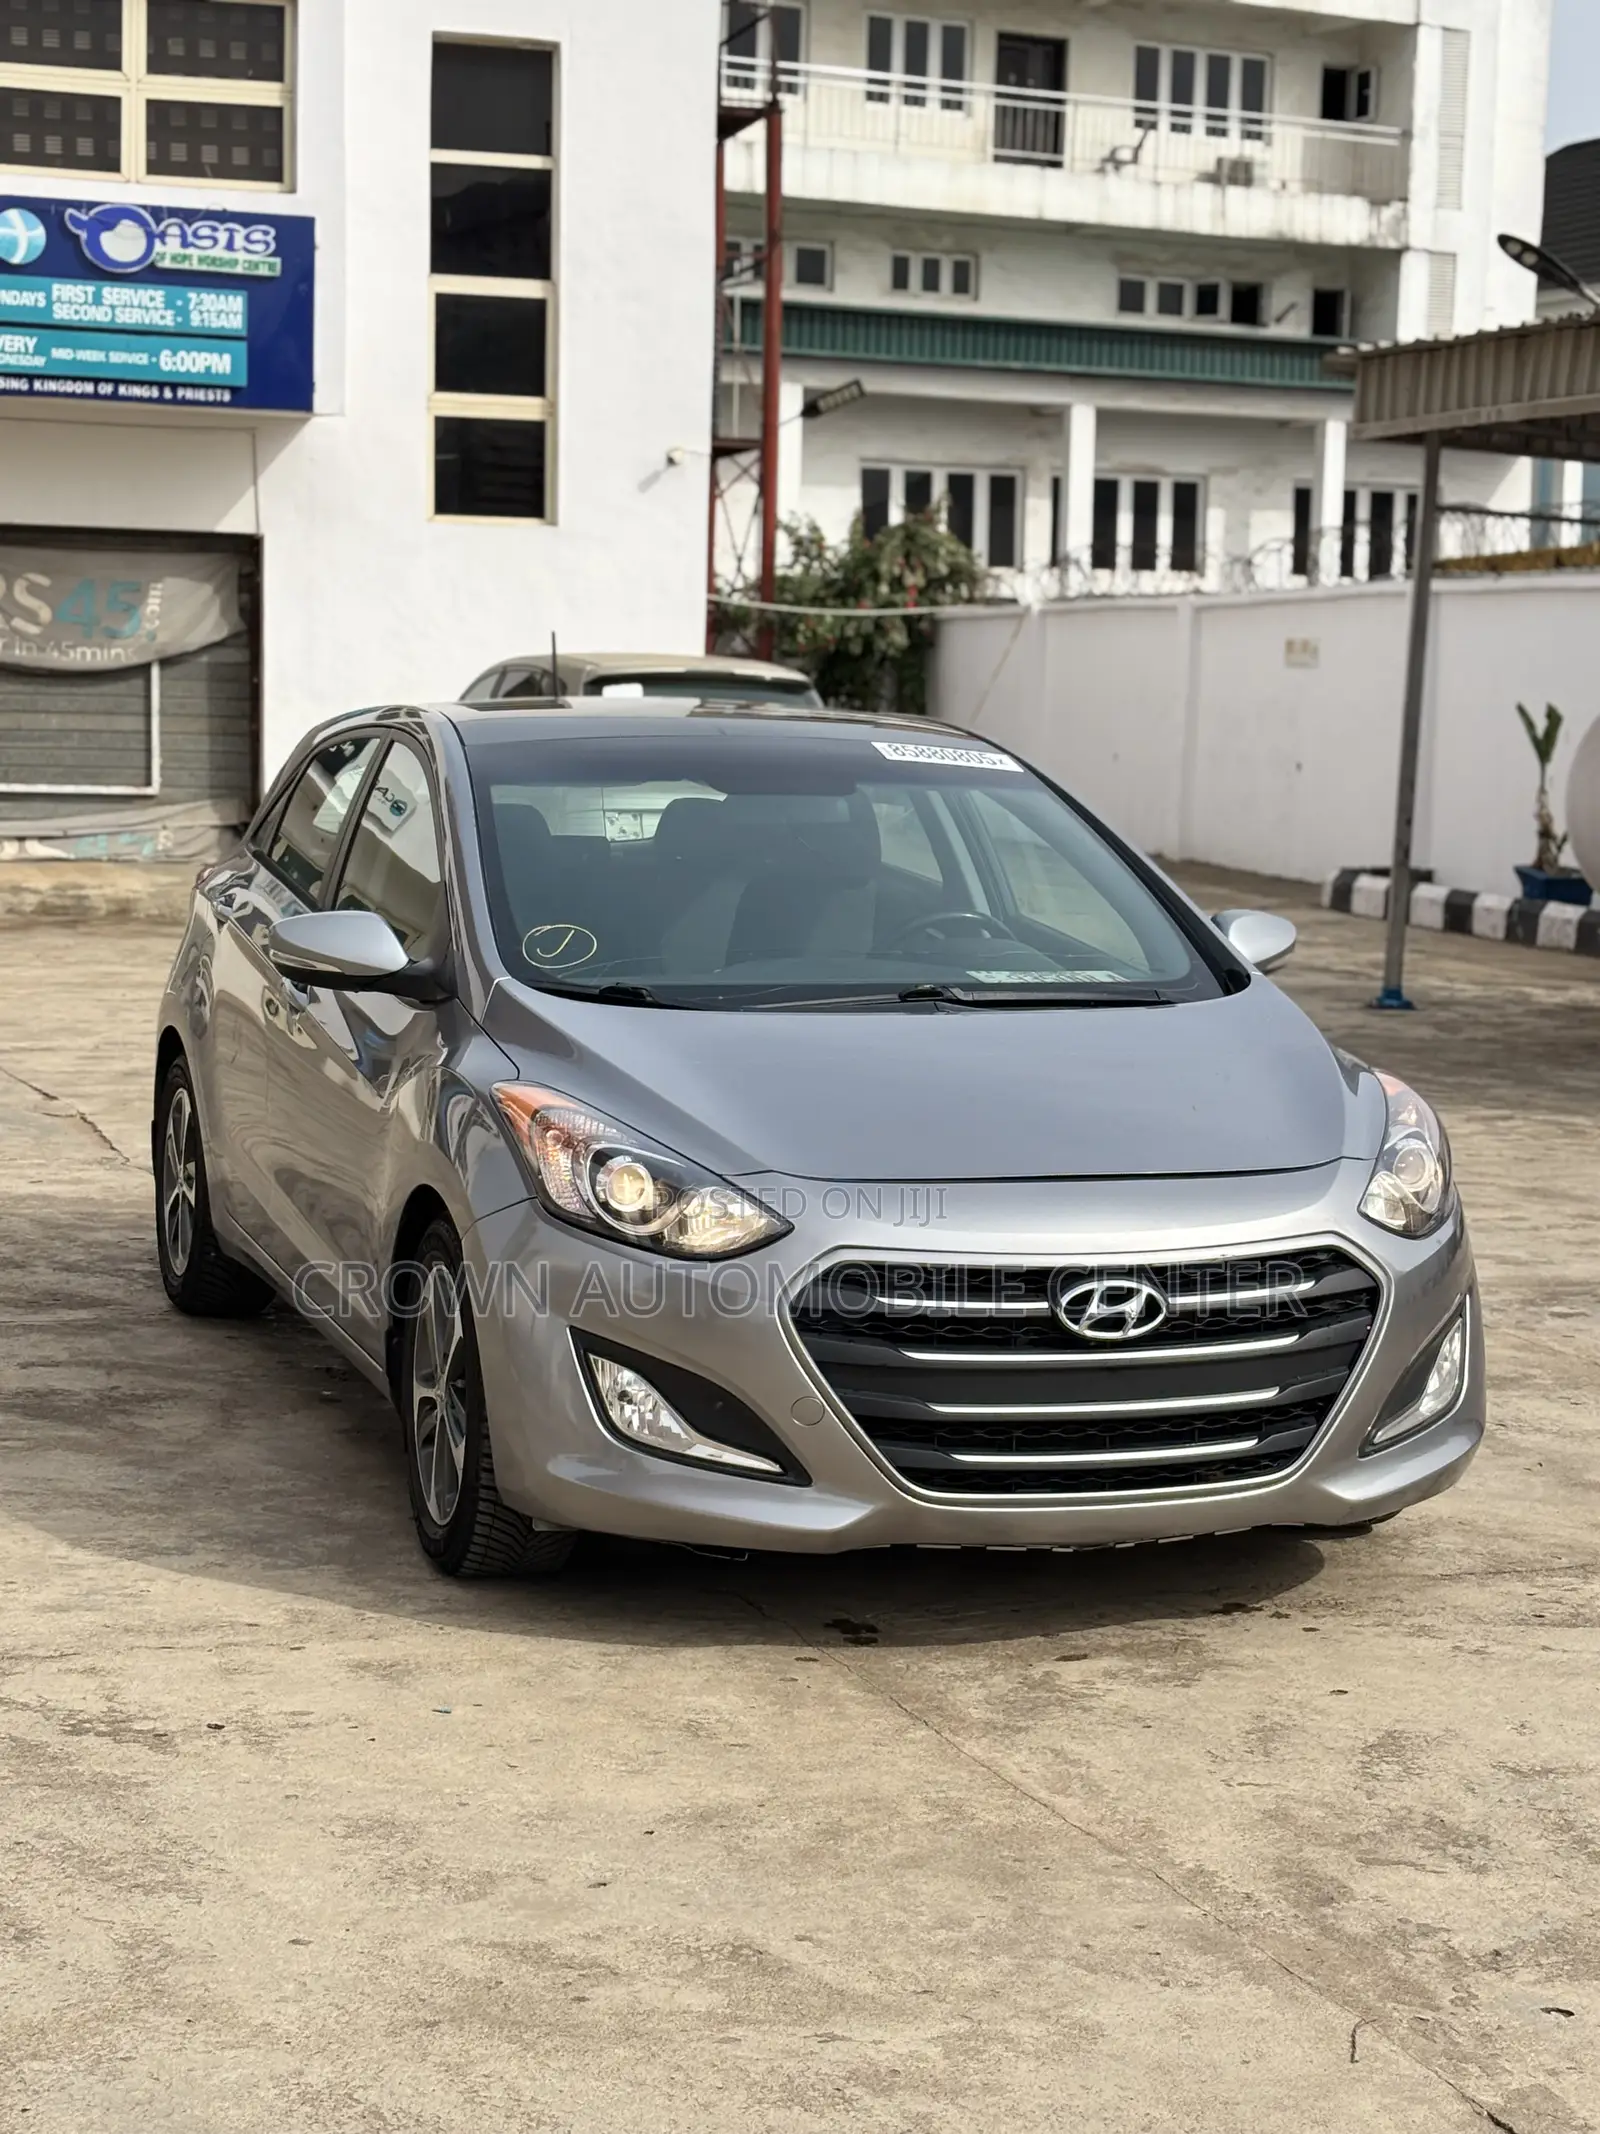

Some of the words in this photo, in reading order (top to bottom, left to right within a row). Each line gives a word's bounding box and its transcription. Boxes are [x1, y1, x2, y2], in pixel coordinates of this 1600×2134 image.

[64, 203, 277, 273] OASIS
[51, 283, 96, 304] FIRST
[102, 287, 165, 309] SERVICE
[52, 302, 112, 322] SECOND
[114, 307, 175, 327] SERVICE
[108, 350, 150, 366] SERVICE
[159, 348, 232, 375] 6:00PM
[33, 378, 95, 395] KINGDOM
[97, 382, 114, 396] OF
[118, 383, 160, 399] KINGS
[163, 386, 173, 399] &
[176, 386, 232, 403] PRIESTS
